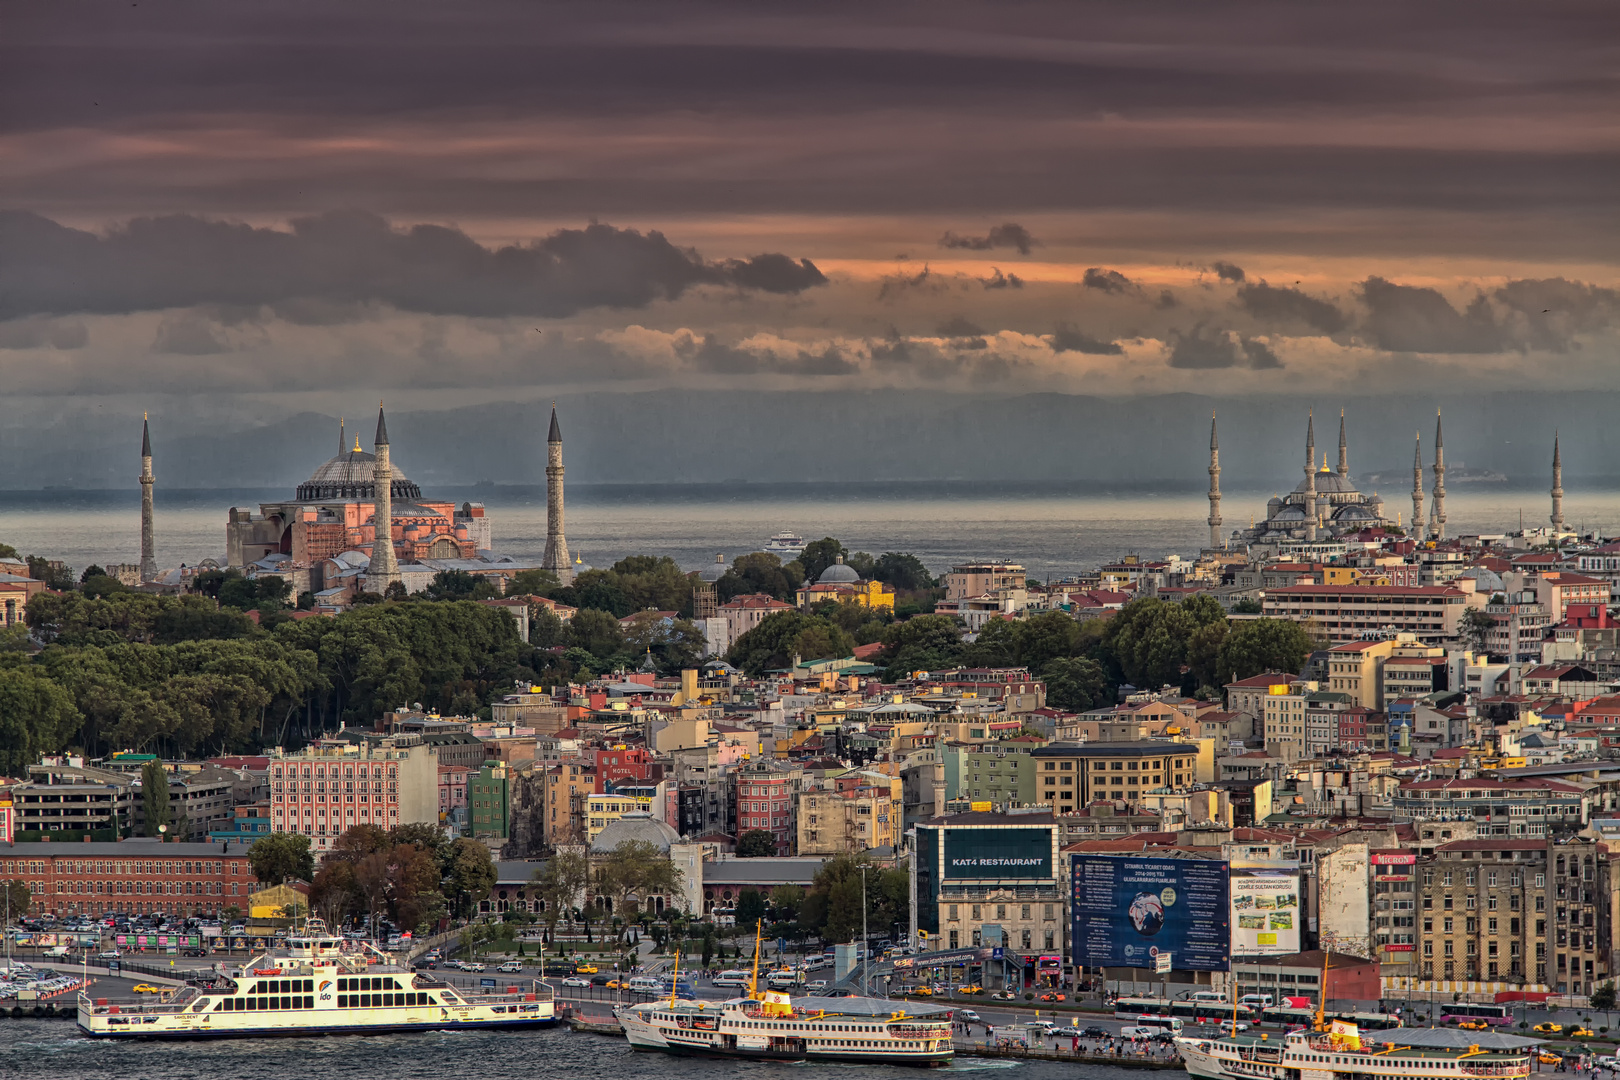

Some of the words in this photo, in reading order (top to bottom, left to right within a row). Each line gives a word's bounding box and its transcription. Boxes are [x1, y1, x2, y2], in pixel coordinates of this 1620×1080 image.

[980, 858, 1043, 866] RESTAURANT
[1378, 855, 1409, 864] MICRON
[319, 992, 332, 1001] ido
